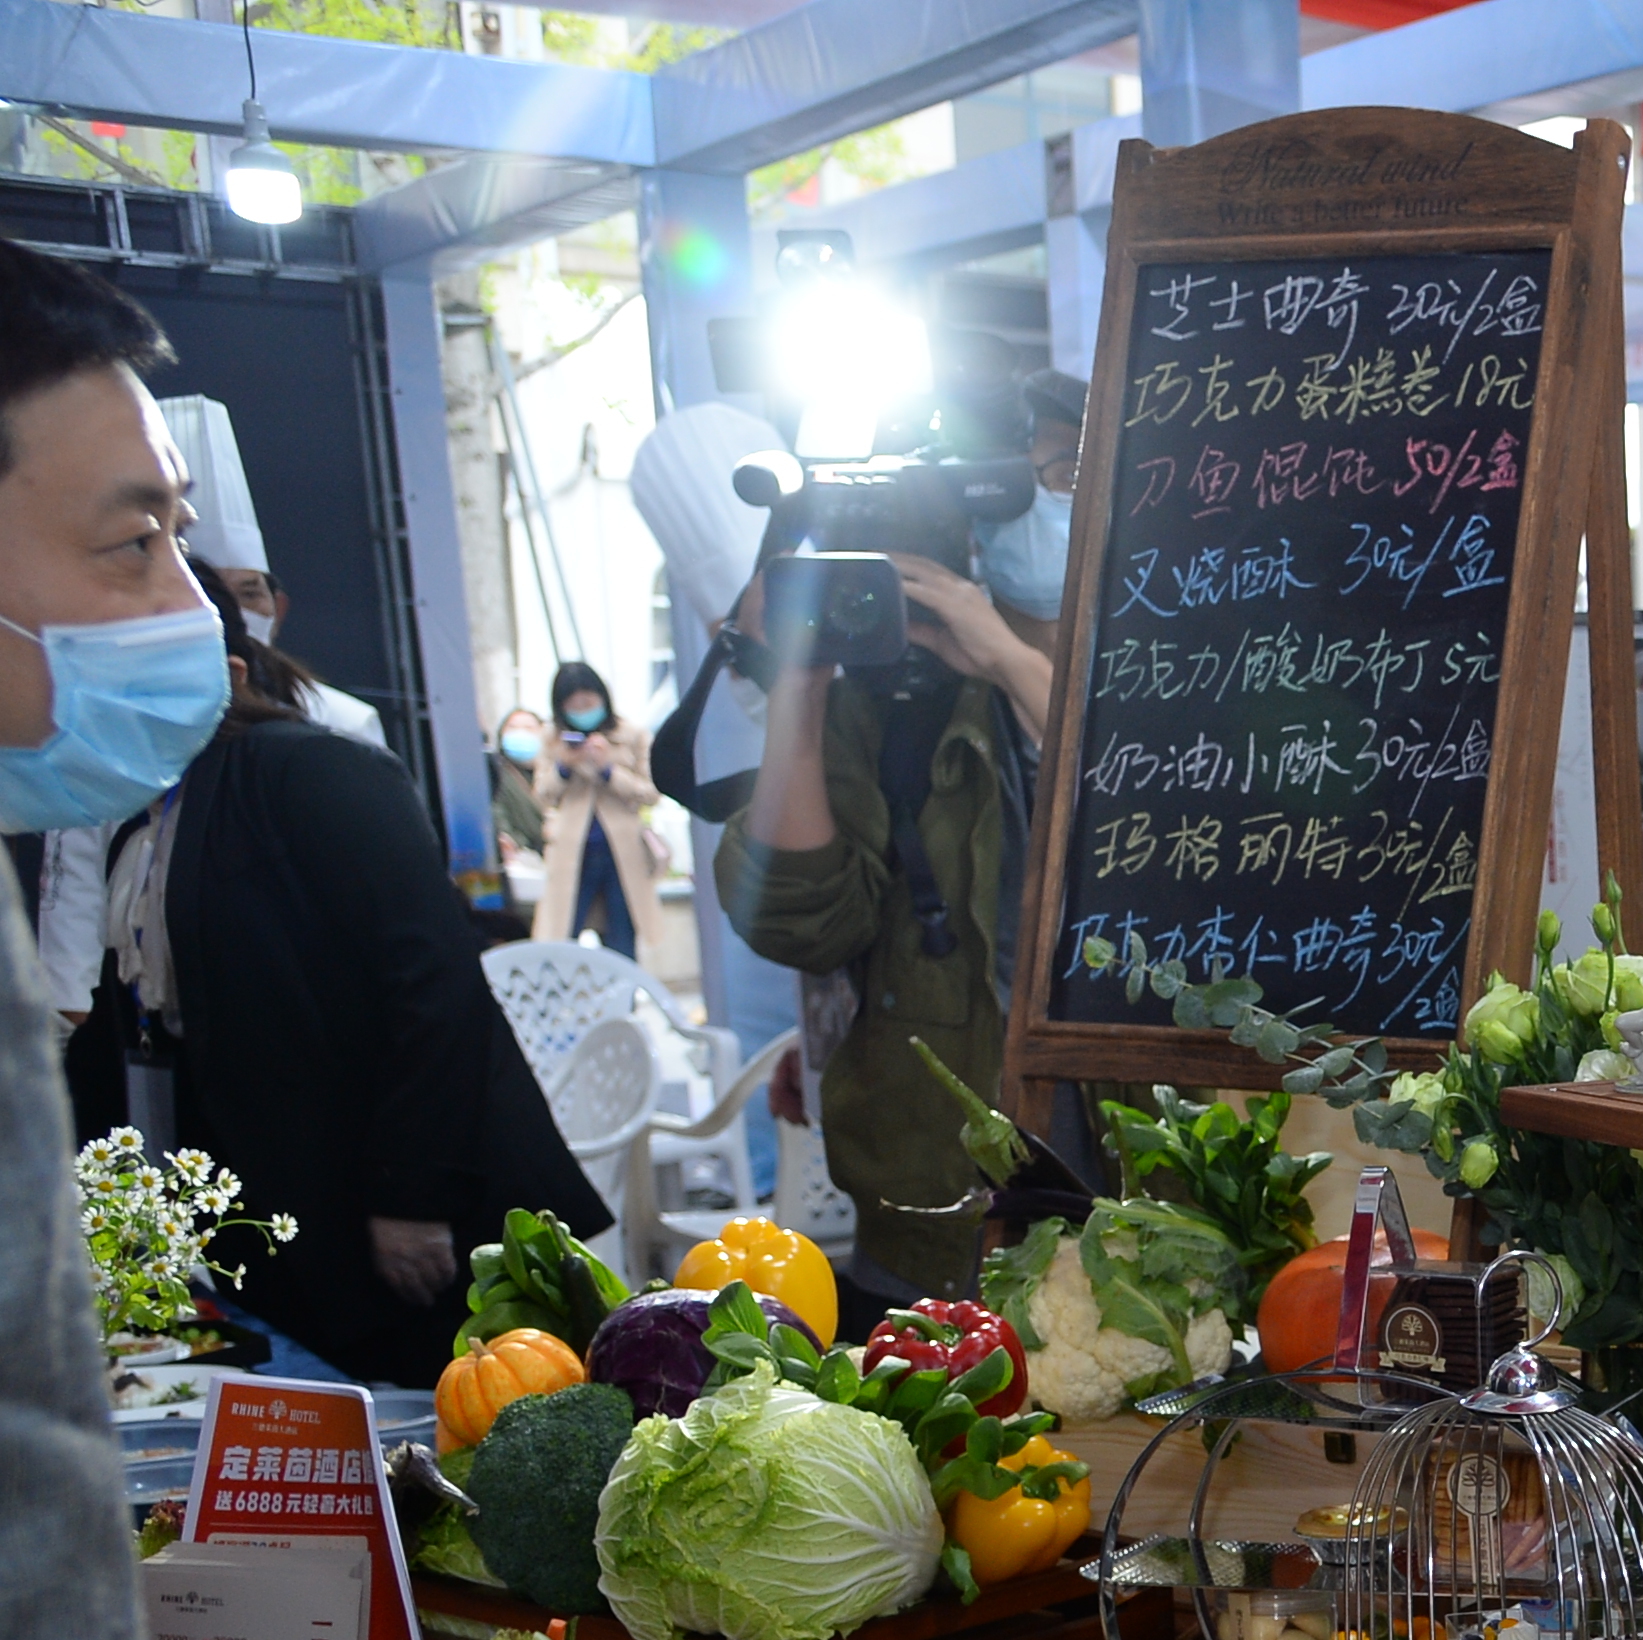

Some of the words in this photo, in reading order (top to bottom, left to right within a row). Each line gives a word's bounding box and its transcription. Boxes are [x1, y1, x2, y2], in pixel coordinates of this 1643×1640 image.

[1150, 267, 1369, 370] 芝士曲奇
[1125, 345, 1450, 427] 巧克力蛋糕卷
[1111, 538, 1318, 617] 叉烧酥
[1339, 515, 1505, 610] 30元/盒
[1441, 632, 1500, 685] 5元
[1084, 720, 1351, 796] 奶油小酥
[232, 1402, 265, 1418] RHINE
[289, 1409, 321, 1424] HOTEL
